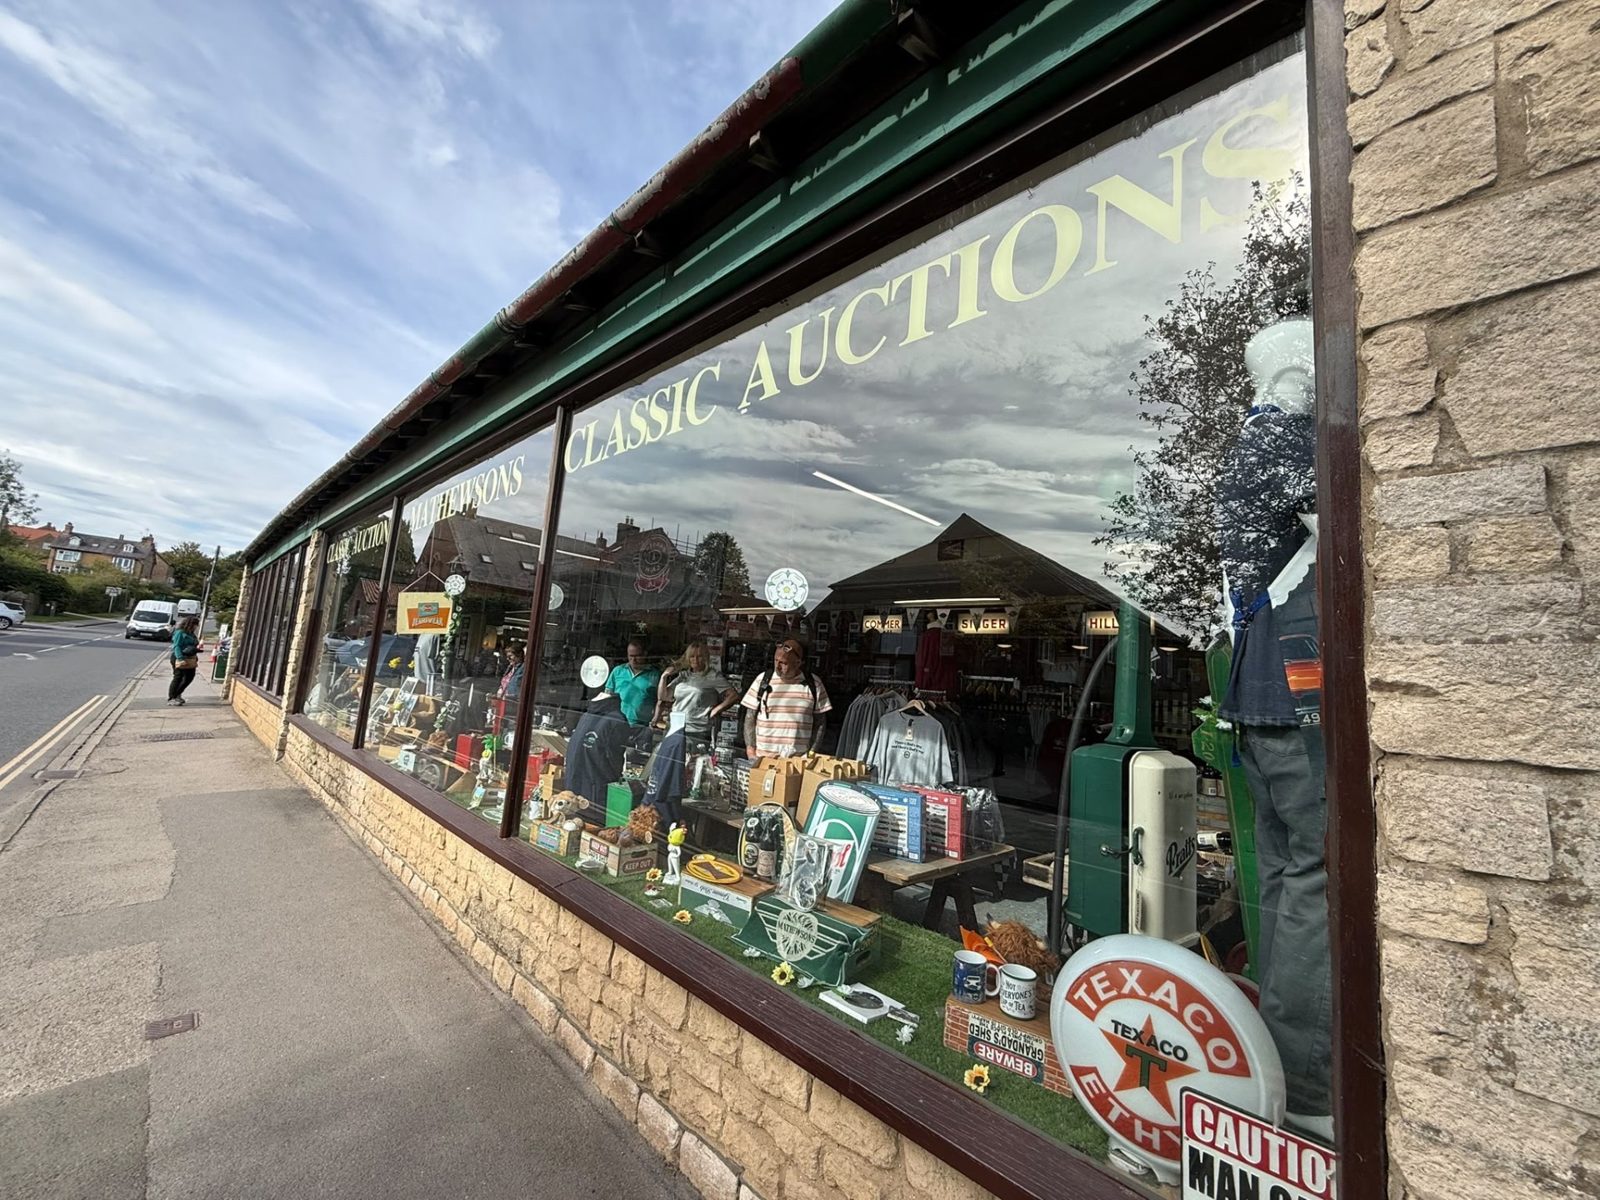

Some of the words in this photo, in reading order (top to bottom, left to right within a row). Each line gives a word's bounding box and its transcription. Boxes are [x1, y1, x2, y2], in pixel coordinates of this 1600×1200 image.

[564, 361, 721, 473] CLASSIC
[737, 93, 1297, 411] AUCTIONS
[408, 455, 525, 533] MATHEWSONS
[961, 619, 1006, 628] SIGER
[624, 862, 639, 871] KEEP
[639, 860, 652, 868] OUT
[777, 921, 816, 944] MATHEWSONS
[1014, 1001, 1026, 1011] TEA
[1073, 967, 1238, 1069] TEXACO
[969, 1023, 992, 1041] SHED
[993, 1031, 1044, 1061] GRANDAD'S
[1111, 1019, 1189, 1062] TEXACO
[977, 1043, 1033, 1076] BEWARE
[1125, 1044, 1167, 1089] T
[1188, 1145, 1260, 1200] MAN
